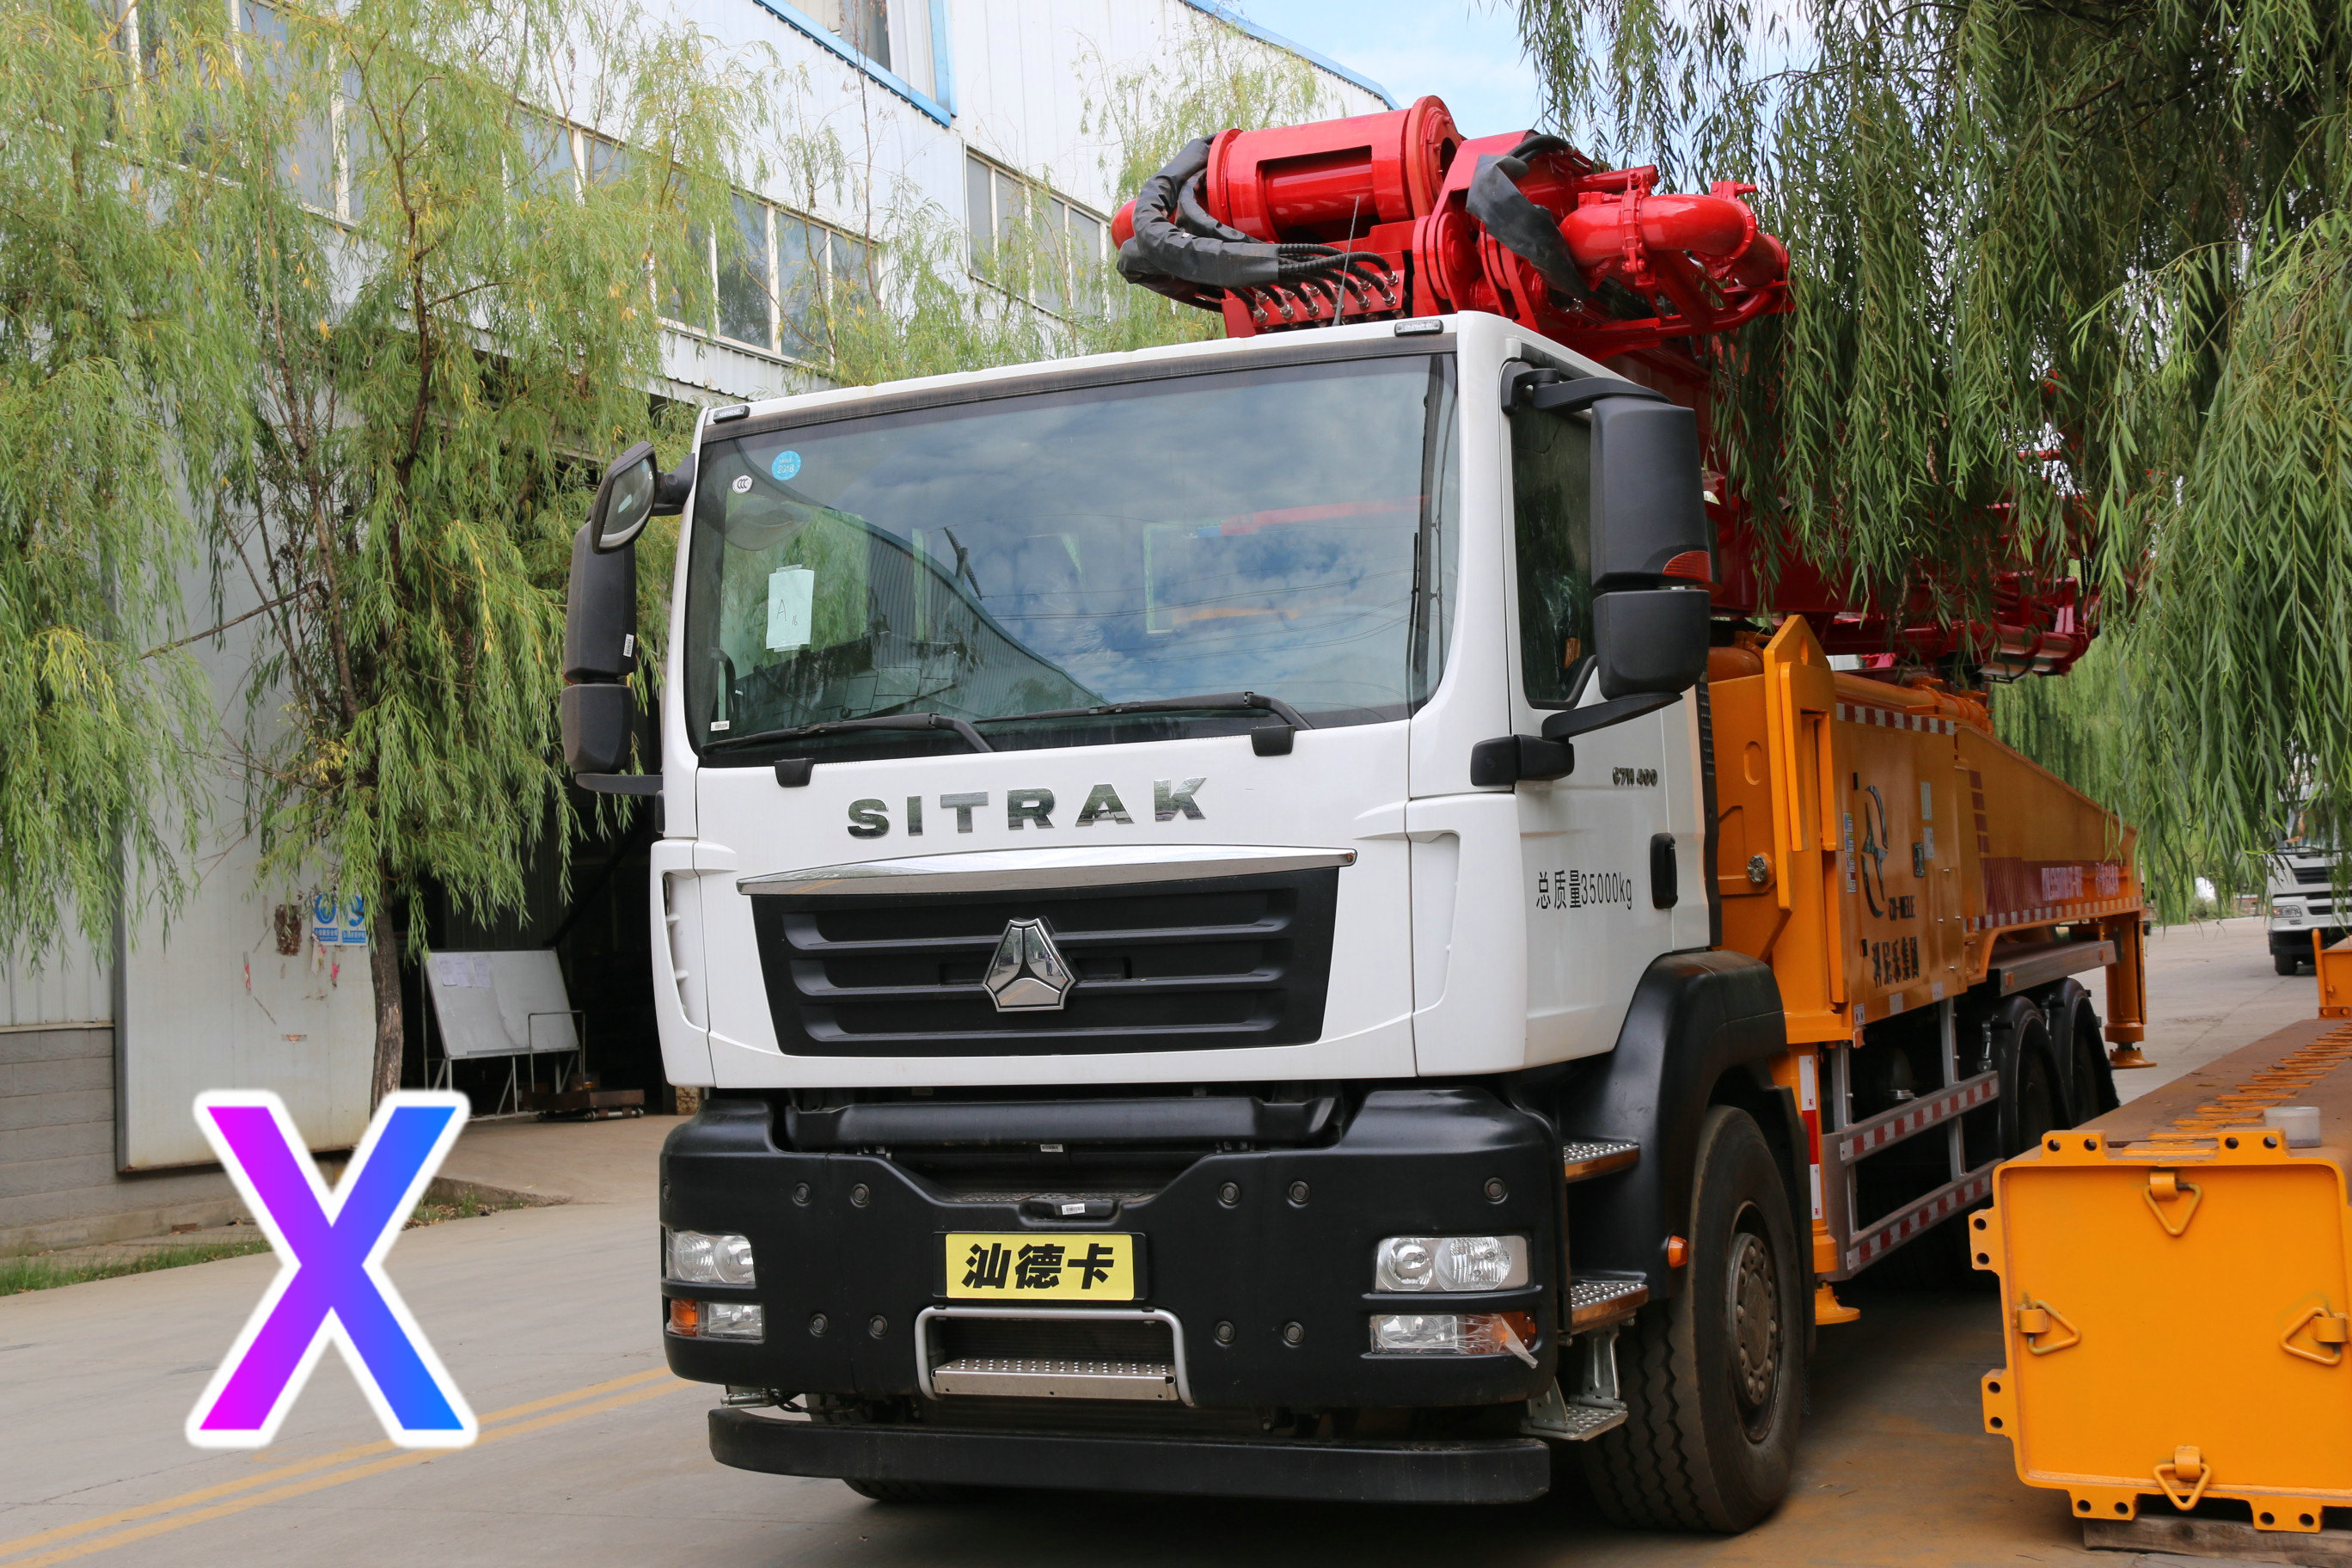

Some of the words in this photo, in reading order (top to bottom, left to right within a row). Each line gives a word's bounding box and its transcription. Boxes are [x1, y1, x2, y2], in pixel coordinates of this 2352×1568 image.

[776, 598, 787, 622] A
[1612, 766, 1634, 787] C7H
[847, 776, 1208, 840] SITRAK
[961, 1242, 1115, 1290] 汕德卡
